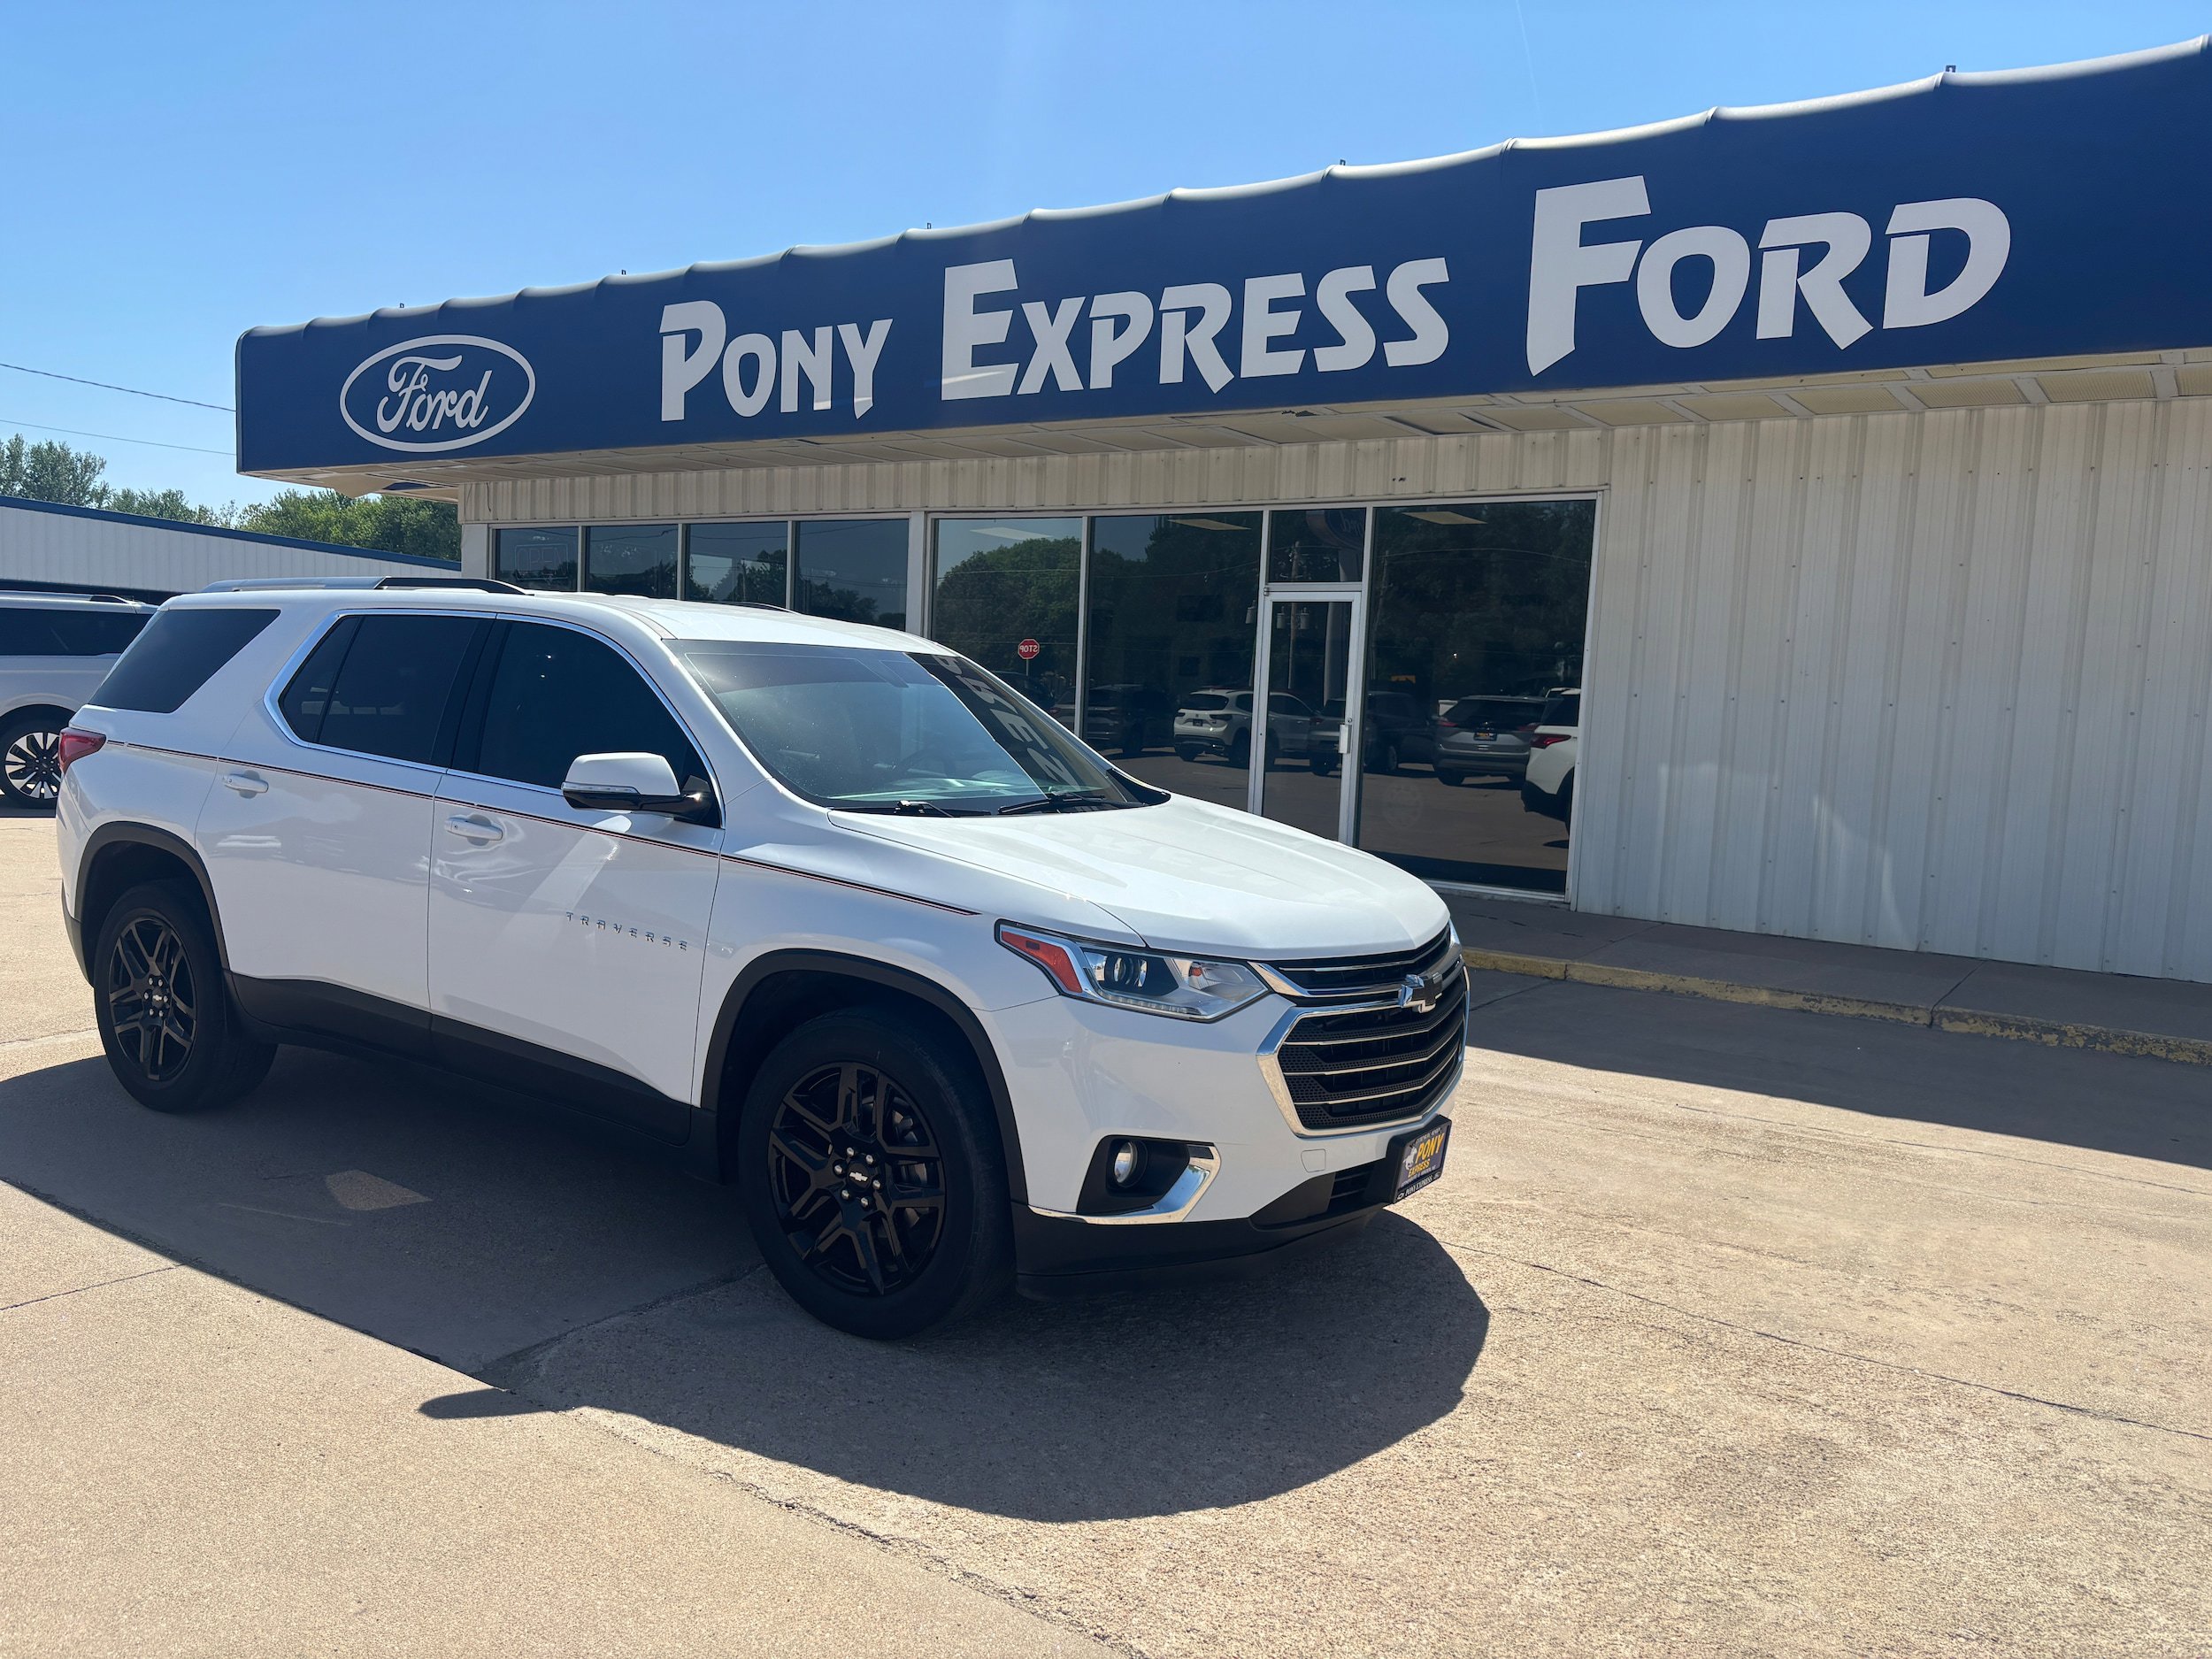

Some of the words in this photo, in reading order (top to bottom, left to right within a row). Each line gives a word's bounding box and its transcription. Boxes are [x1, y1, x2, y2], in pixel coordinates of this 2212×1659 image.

[659, 300, 894, 421] PONY
[941, 257, 1450, 401] EXPRESS
[1525, 174, 2011, 377] FORD
[376, 355, 493, 434] Ford
[565, 910, 687, 951] TRAVERSE
[1408, 1158, 1431, 1179] EXPRESS
[1416, 1133, 1445, 1164] PONY
